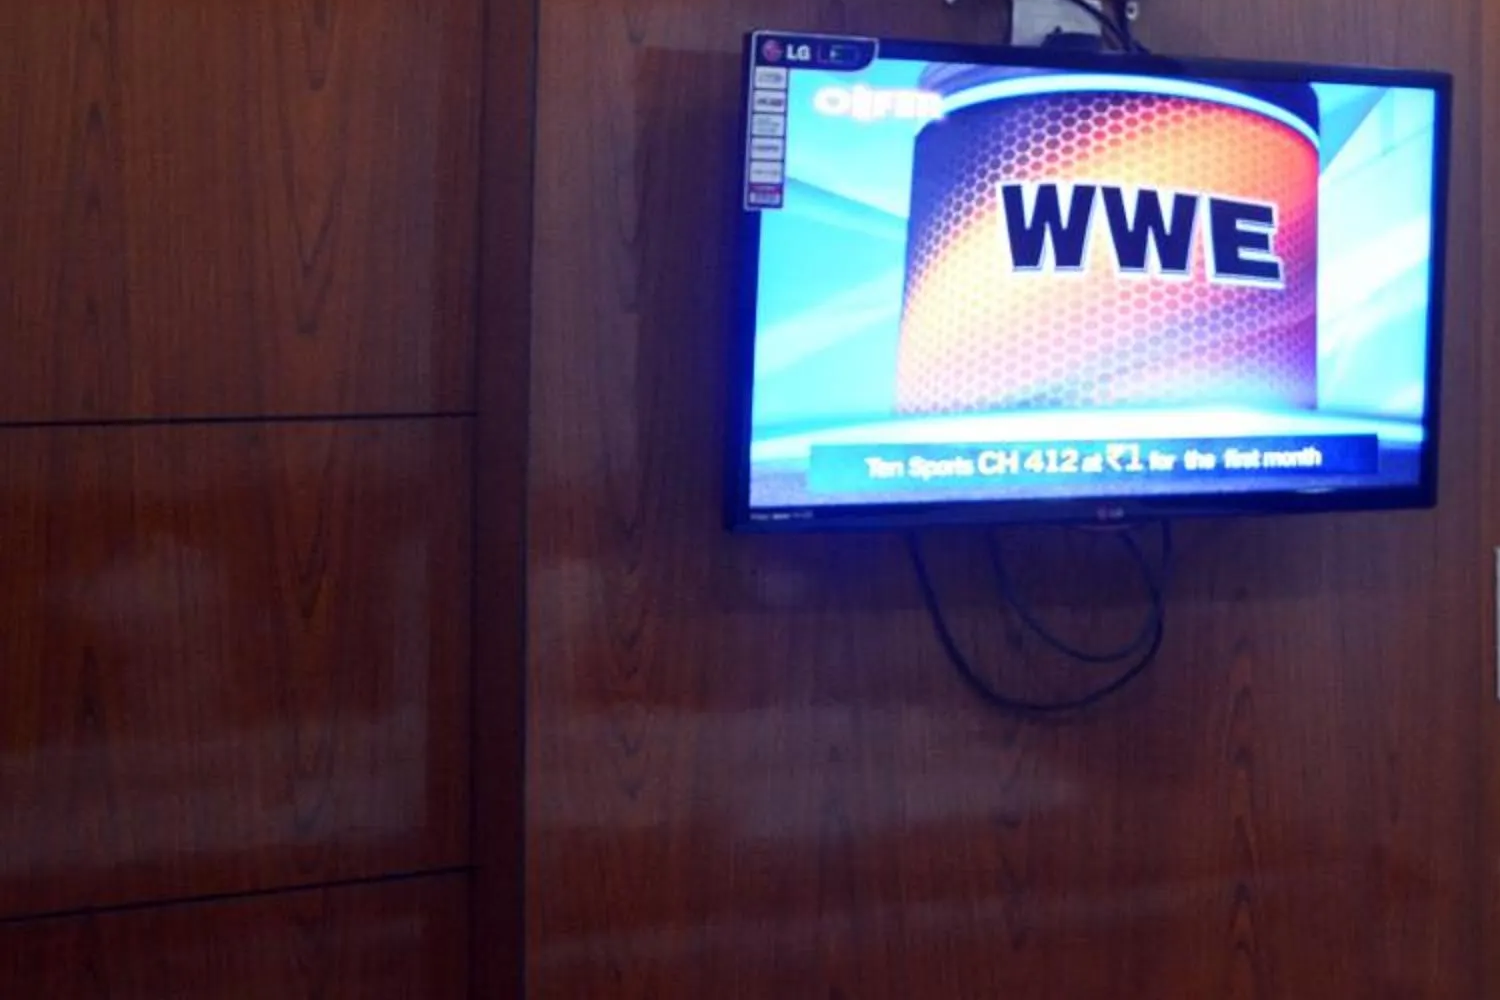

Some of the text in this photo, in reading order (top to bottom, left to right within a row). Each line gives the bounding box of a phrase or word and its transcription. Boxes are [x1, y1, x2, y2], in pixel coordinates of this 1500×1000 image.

[786, 43, 811, 61] LG
[1000, 182, 1284, 288] WWE
[977, 449, 1020, 476] CH
[1024, 448, 1079, 474] 412
